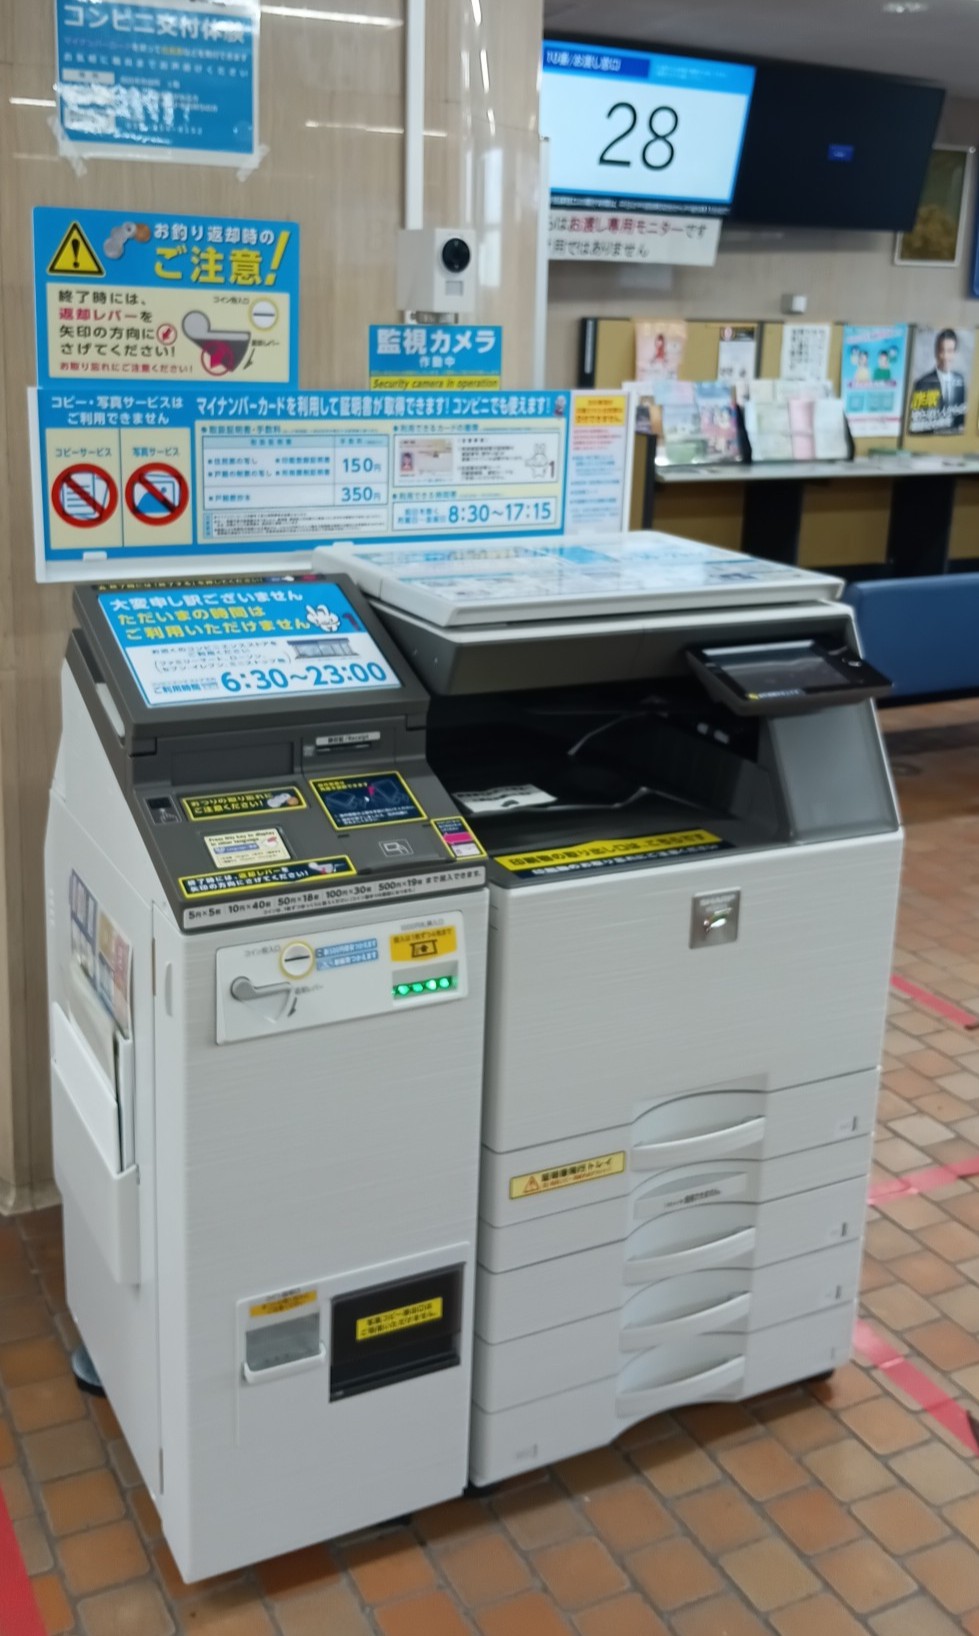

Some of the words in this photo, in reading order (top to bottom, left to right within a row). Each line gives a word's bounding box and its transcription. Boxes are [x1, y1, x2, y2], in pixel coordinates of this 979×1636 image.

[598, 101, 680, 171] 28
[153, 223, 275, 245] お釣り返却時の
[549, 239, 650, 258] 用ではありません
[58, 289, 148, 305] 終了時には、
[58, 307, 153, 323] 返却レバーを
[59, 325, 155, 339] 矢印の方向に
[377, 328, 496, 355] 監視カメラ
[60, 344, 176, 358] さげてください!
[372, 379, 409, 390] Security
[411, 380, 444, 389] camera
[446, 379, 456, 388] in
[458, 379, 498, 390] operation
[51, 396, 183, 410] コピー・写真サービスは
[67, 412, 169, 425] ご利用できません
[55, 447, 112, 457] コピーサービス
[132, 446, 179, 457] 写真サービス
[342, 457, 383, 474] 150円
[341, 486, 382, 502] 350円
[110, 590, 304, 612] 大変申し訳ございません
[118, 606, 266, 625] ただいまの時間は
[126, 618, 311, 640] ご利用いただけません
